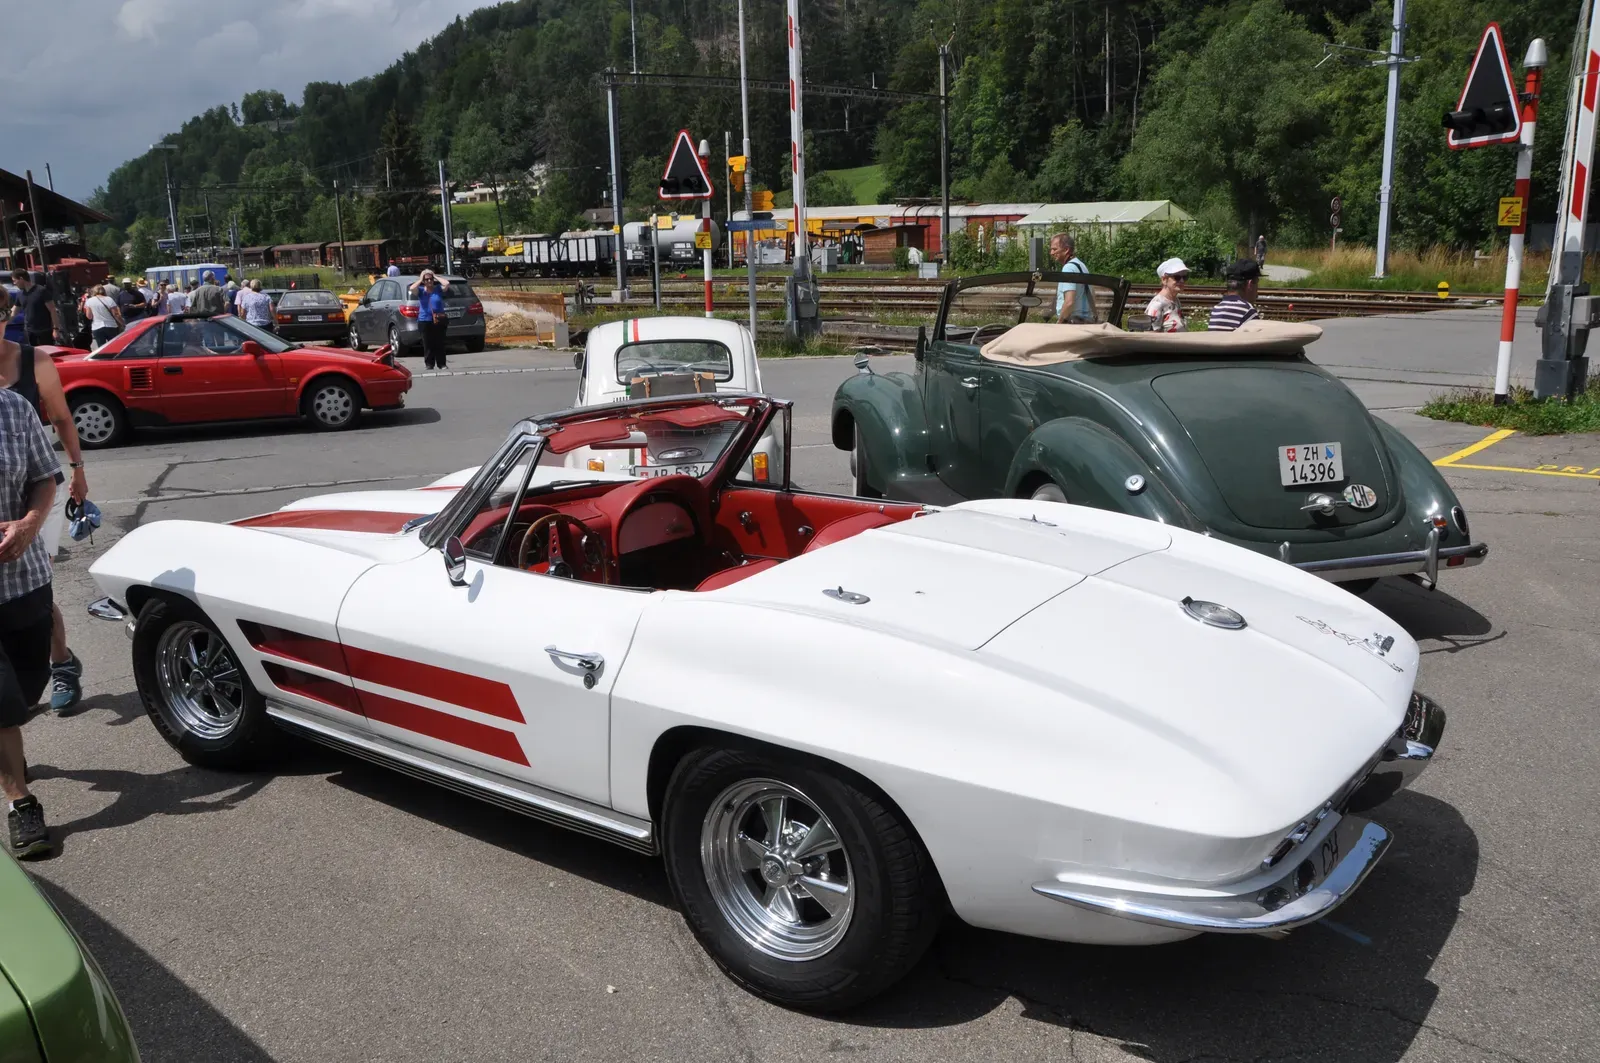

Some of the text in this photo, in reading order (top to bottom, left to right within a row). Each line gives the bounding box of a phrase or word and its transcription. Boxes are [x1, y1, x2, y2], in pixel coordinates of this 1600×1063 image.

[1303, 446, 1319, 461] ZH
[1290, 461, 1336, 483] 14396
[1351, 485, 1369, 507] CH
